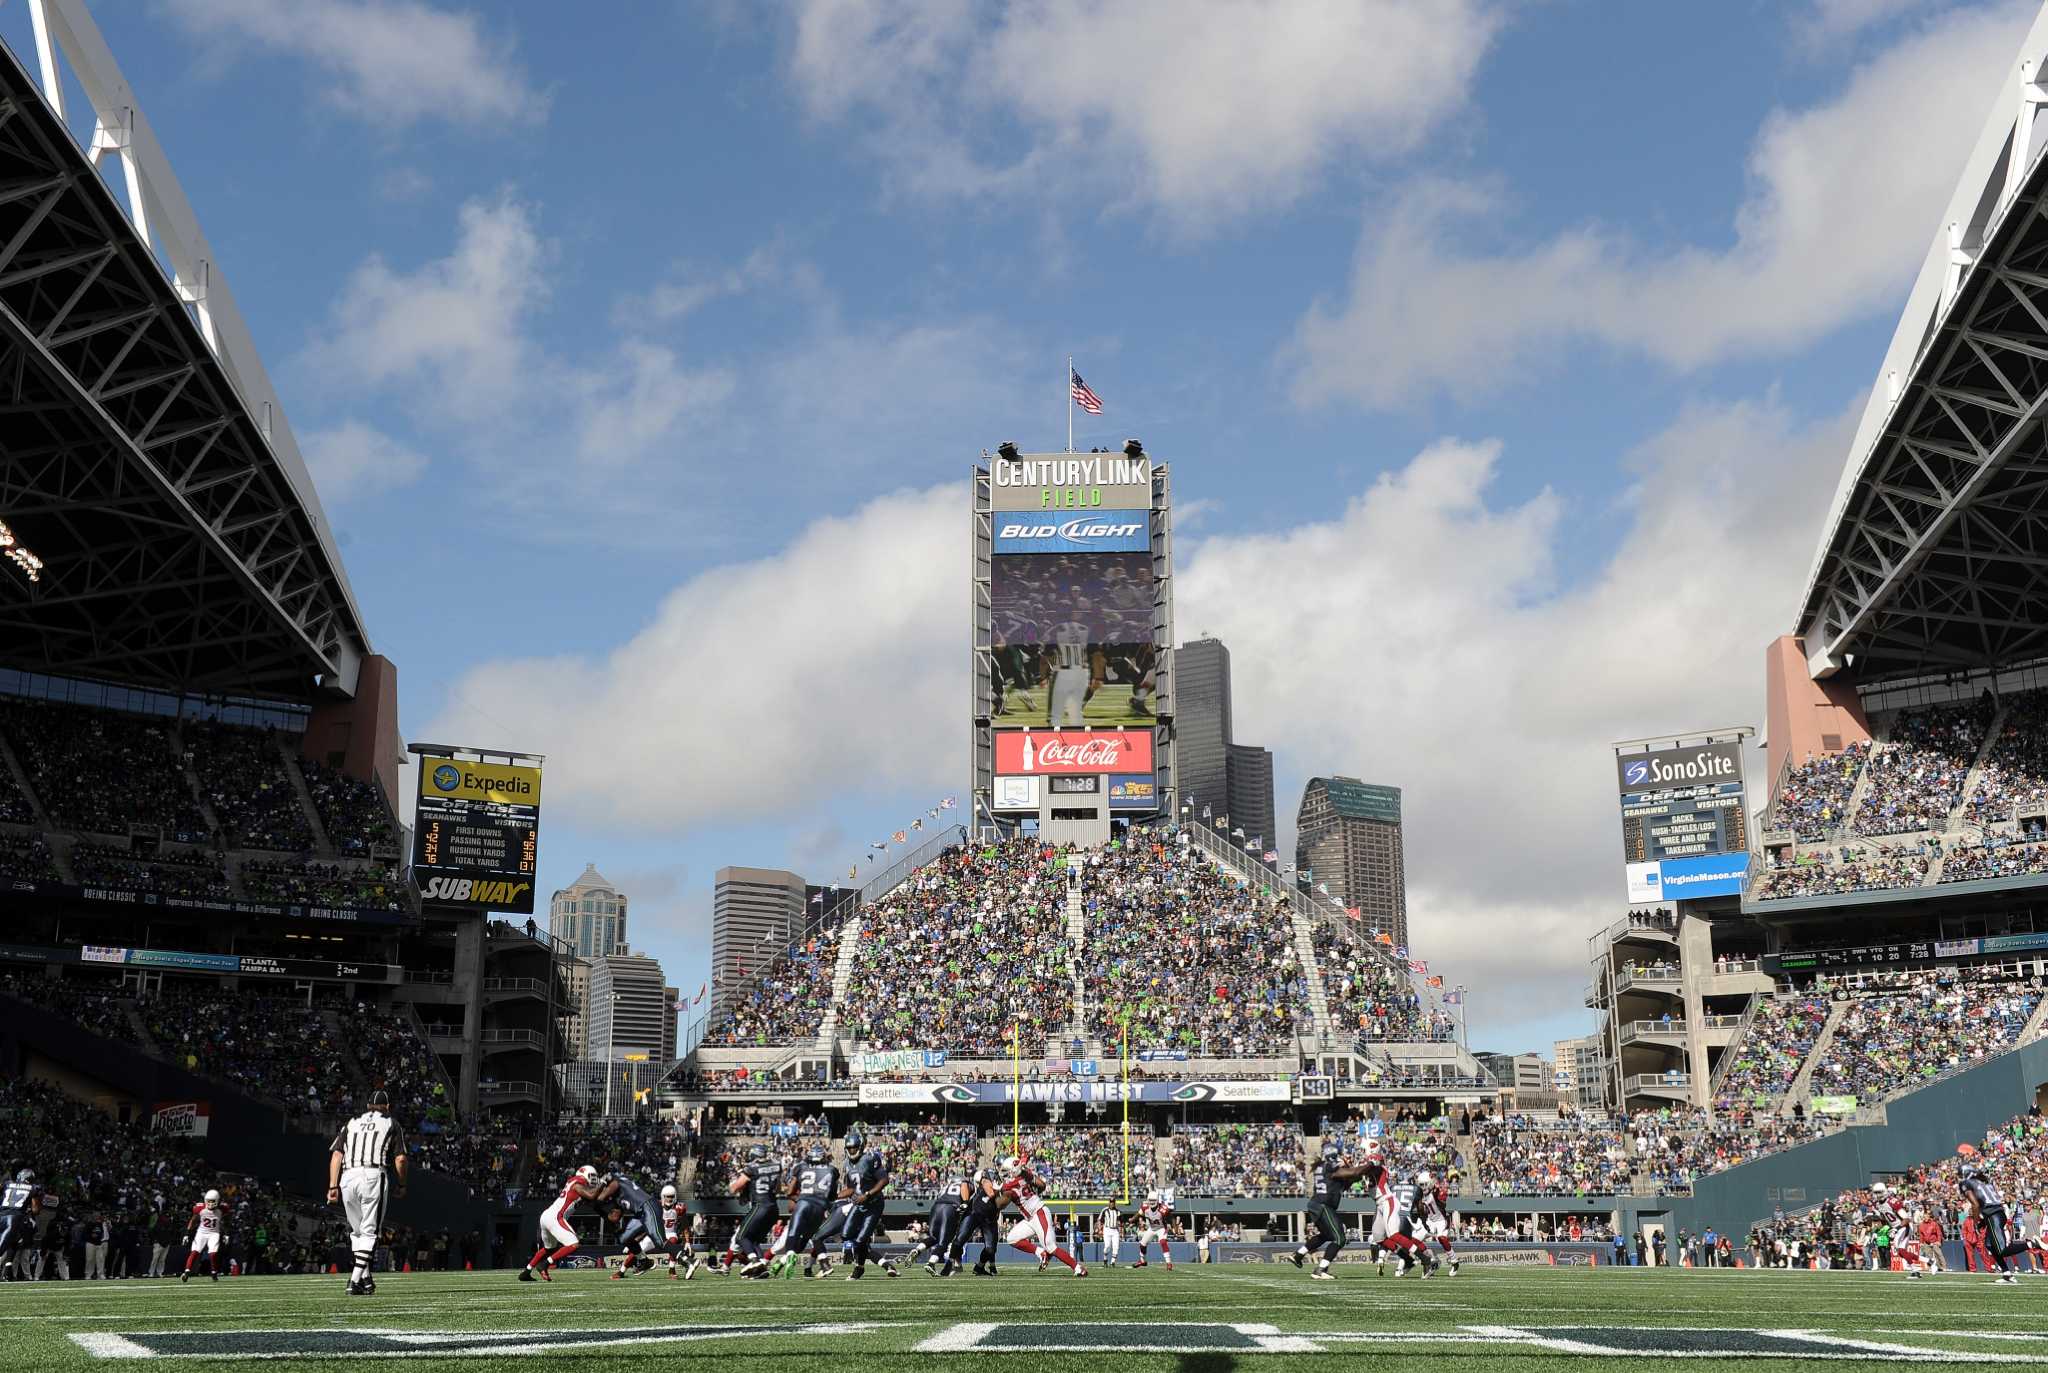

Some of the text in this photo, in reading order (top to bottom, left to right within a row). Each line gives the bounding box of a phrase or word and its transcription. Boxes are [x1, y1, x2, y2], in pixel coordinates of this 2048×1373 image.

[996, 458, 1147, 487] CENTURYLINK
[1042, 488, 1102, 507] FIELD
[999, 524, 1144, 538] BUD LIGHT
[1038, 739, 1124, 766] Coca-Cola
[1651, 752, 1733, 783] SonoSite
[463, 772, 530, 794] Expedia
[1640, 787, 1721, 802] DEFENSE
[441, 802, 520, 814] OFFENSE
[1696, 798, 1739, 809] VISITORS
[423, 812, 467, 822] SEAHAWKS
[1624, 805, 1669, 817] SEAHAWKS
[494, 819, 534, 828] VISITORS
[1672, 814, 1695, 824] SACKS
[432, 822, 439, 832] 5
[476, 828, 502, 837] DOWNS
[425, 833, 438, 843] 42
[450, 836, 506, 848] PASSING YARDS
[1659, 833, 1710, 845] THREE AND OUT
[449, 846, 506, 858] RUSHING YARDS
[1665, 844, 1707, 855] TAKEAWAYS
[455, 856, 500, 867] TOTAL YARDS
[420, 877, 530, 904] SUBWAY
[240, 958, 277, 967] ATLANTA
[240, 965, 268, 973] TAMPA
[928, 1052, 943, 1066] 12
[1076, 1061, 1092, 1075] 12
[1005, 1082, 1145, 1101] HAWKS NEST
[1305, 1080, 1328, 1096] 40
[360, 1122, 376, 1131] 70
[1363, 1123, 1379, 1138] 12
[800, 1171, 833, 1197] 24
[2, 1189, 30, 1207] 17
[203, 1218, 217, 1228] 21
[1474, 1253, 1540, 1263] 888-NFL-HAWK
